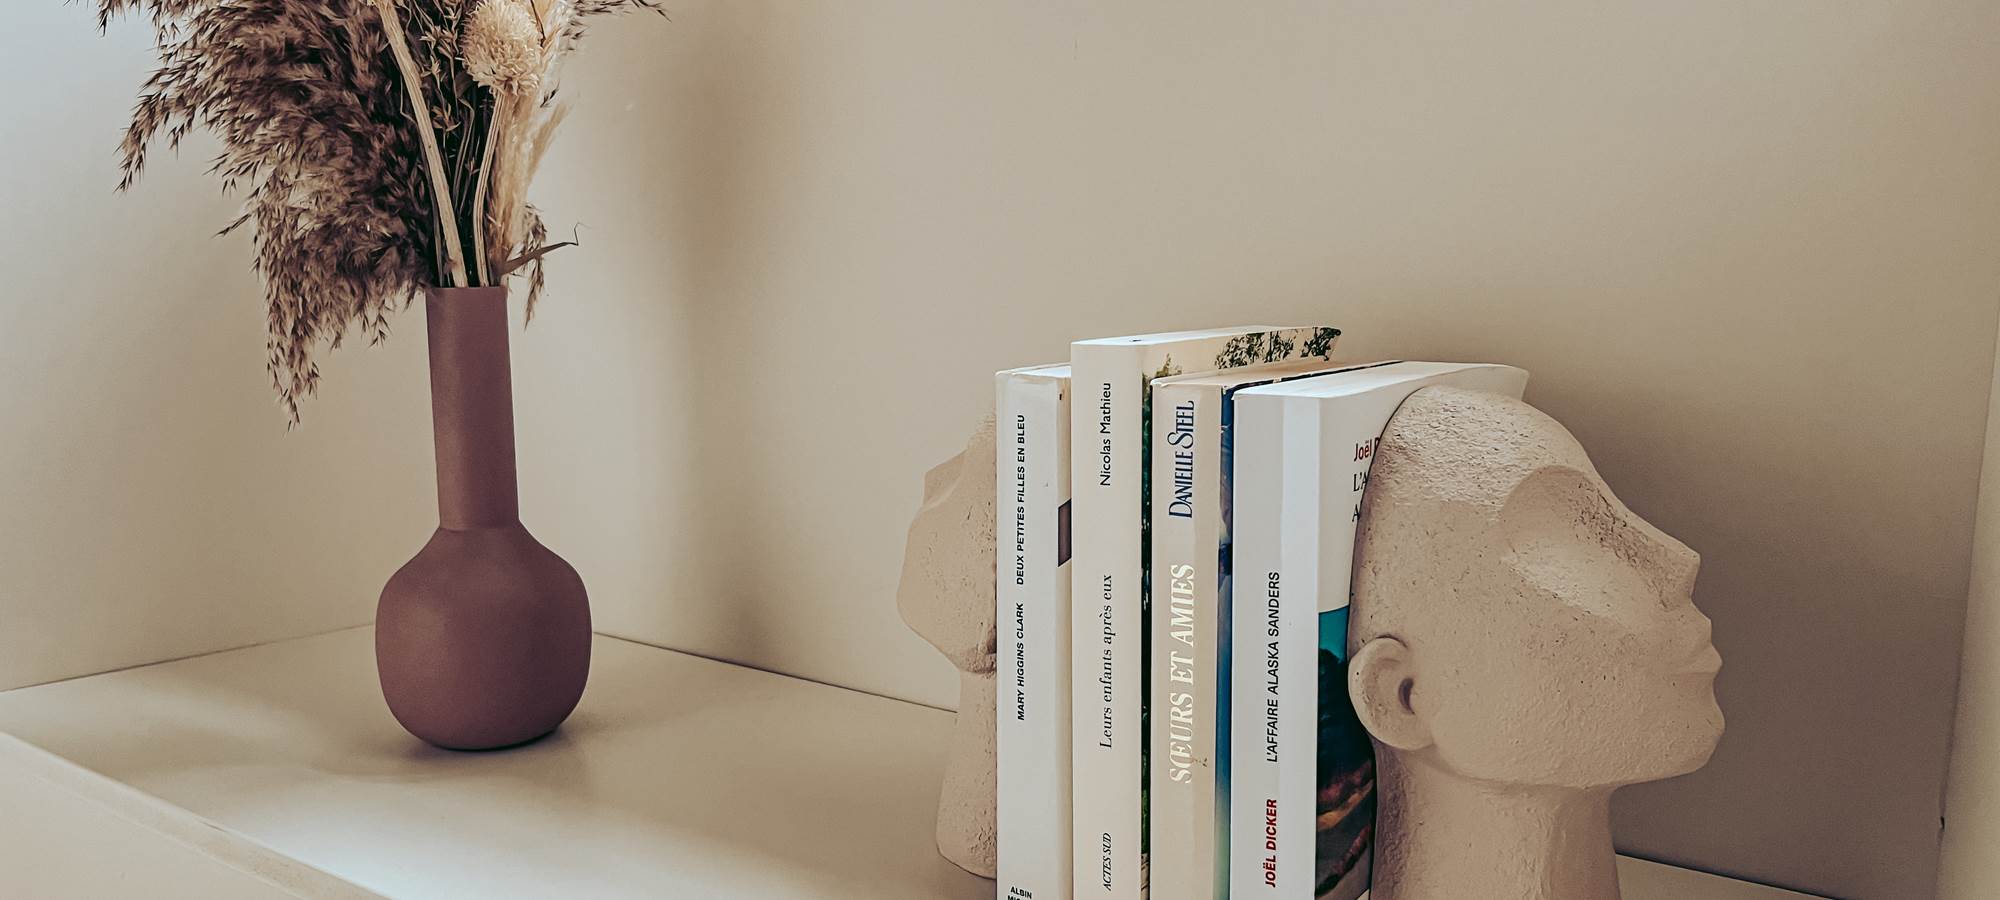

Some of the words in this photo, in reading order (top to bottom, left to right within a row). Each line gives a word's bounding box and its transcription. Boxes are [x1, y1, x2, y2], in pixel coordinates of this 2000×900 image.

[1100, 383, 1111, 434] Mathieu
[1167, 400, 1194, 449] STEEL
[1017, 414, 1025, 444] BLEU
[1017, 447, 1025, 463] EN
[1100, 438, 1111, 486] Nicolas
[1353, 438, 1372, 462] Joël
[1017, 466, 1025, 503] FILLES
[1168, 451, 1193, 518] DANIELLE
[1017, 506, 1025, 552] PETITES
[1016, 556, 1024, 585] DEUX
[1103, 574, 1112, 600] eux
[1016, 602, 1024, 640] CLARK
[1170, 564, 1195, 648] AMIES
[1268, 571, 1280, 637] SANDERS
[1099, 605, 1116, 645] après
[1017, 642, 1025, 687] HIGGINS
[1099, 649, 1112, 702] enfants
[1170, 651, 1194, 686] ET
[1267, 641, 1279, 695] ALASKA
[1017, 689, 1025, 720] MARY
[1100, 707, 1112, 748] Leurs
[1266, 698, 1278, 763] L'AFFAIRE
[1102, 832, 1111, 855] SUD
[1266, 799, 1277, 850] DICKER
[1102, 855, 1111, 892] ACTES
[1262, 855, 1276, 888] JOËL
[1010, 886, 1032, 899] ALBIN
